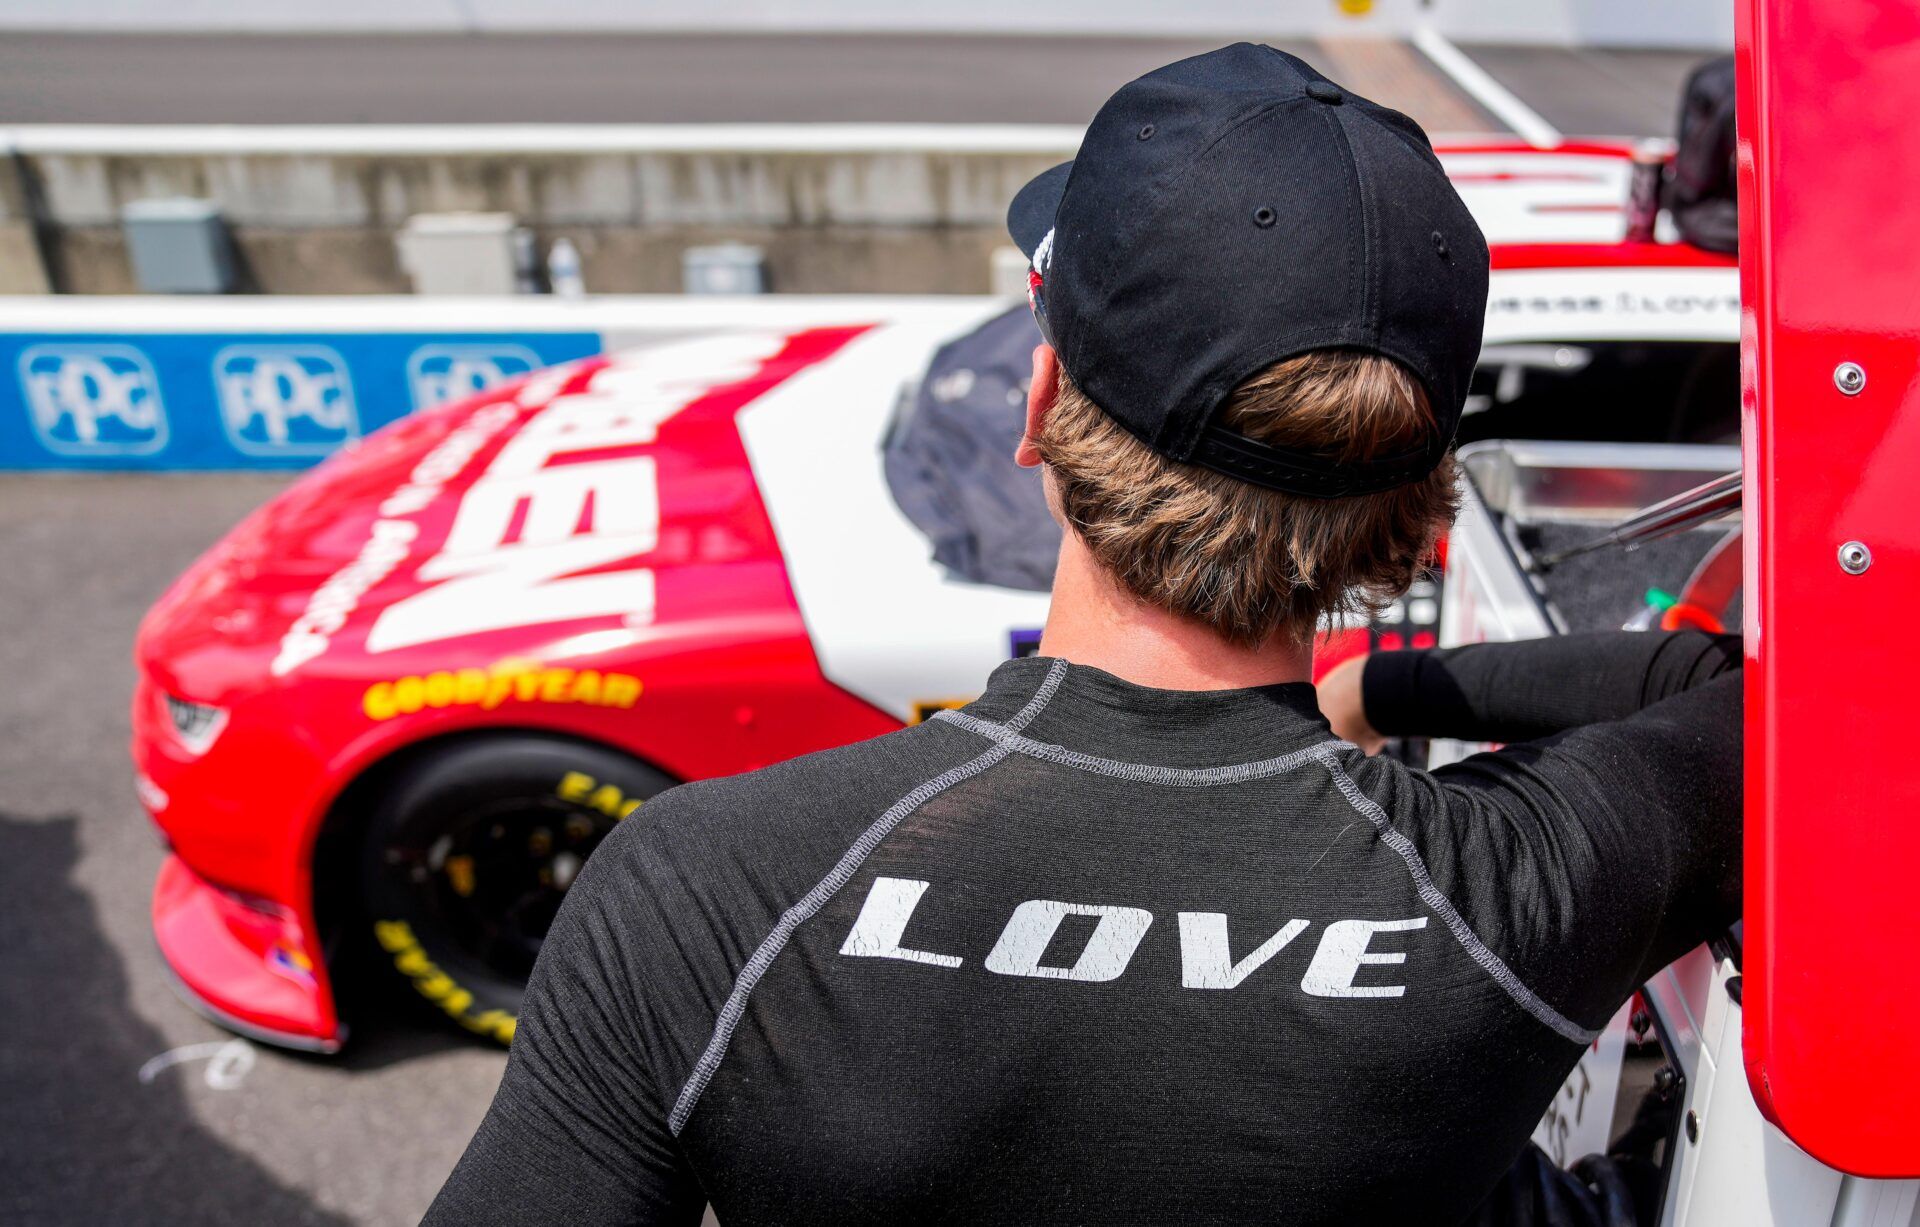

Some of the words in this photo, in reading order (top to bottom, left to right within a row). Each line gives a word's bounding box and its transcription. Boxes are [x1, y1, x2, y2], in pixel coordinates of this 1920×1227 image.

[29, 357, 157, 444] PPG
[223, 357, 351, 444] PPG
[362, 658, 645, 721] GOODYEAR
[838, 876, 1429, 998] LOVE
